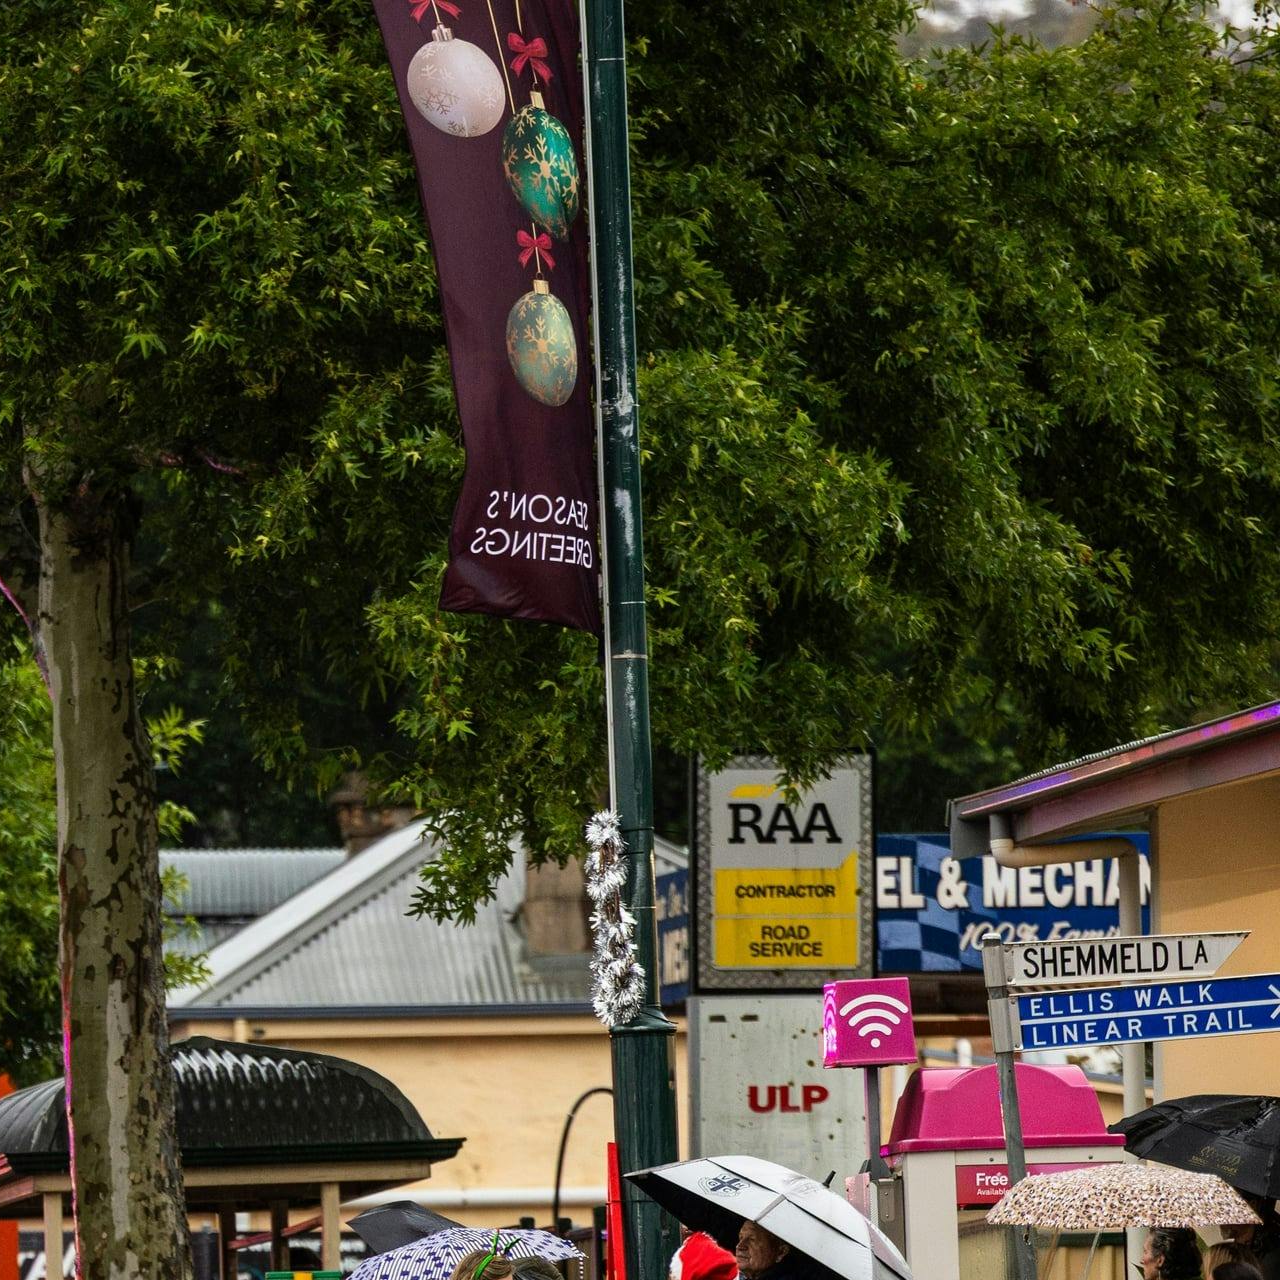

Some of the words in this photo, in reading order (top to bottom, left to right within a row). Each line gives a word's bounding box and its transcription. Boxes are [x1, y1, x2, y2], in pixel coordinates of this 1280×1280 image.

[727, 803, 842, 844] RAA
[735, 885, 836, 898] CONTRACTOR
[937, 858, 970, 910] &
[761, 926, 810, 940] ROAD
[749, 943, 823, 957] SERVICE
[1023, 942, 1169, 978] SHEMMELD
[1030, 992, 1114, 1017] ELLIS
[1134, 984, 1214, 1009] WALK
[1031, 1018, 1143, 1046] LINEAR
[1164, 1010, 1253, 1035] TRAIL
[747, 1084, 830, 1114] ULP
[975, 1171, 1009, 1187] Free
